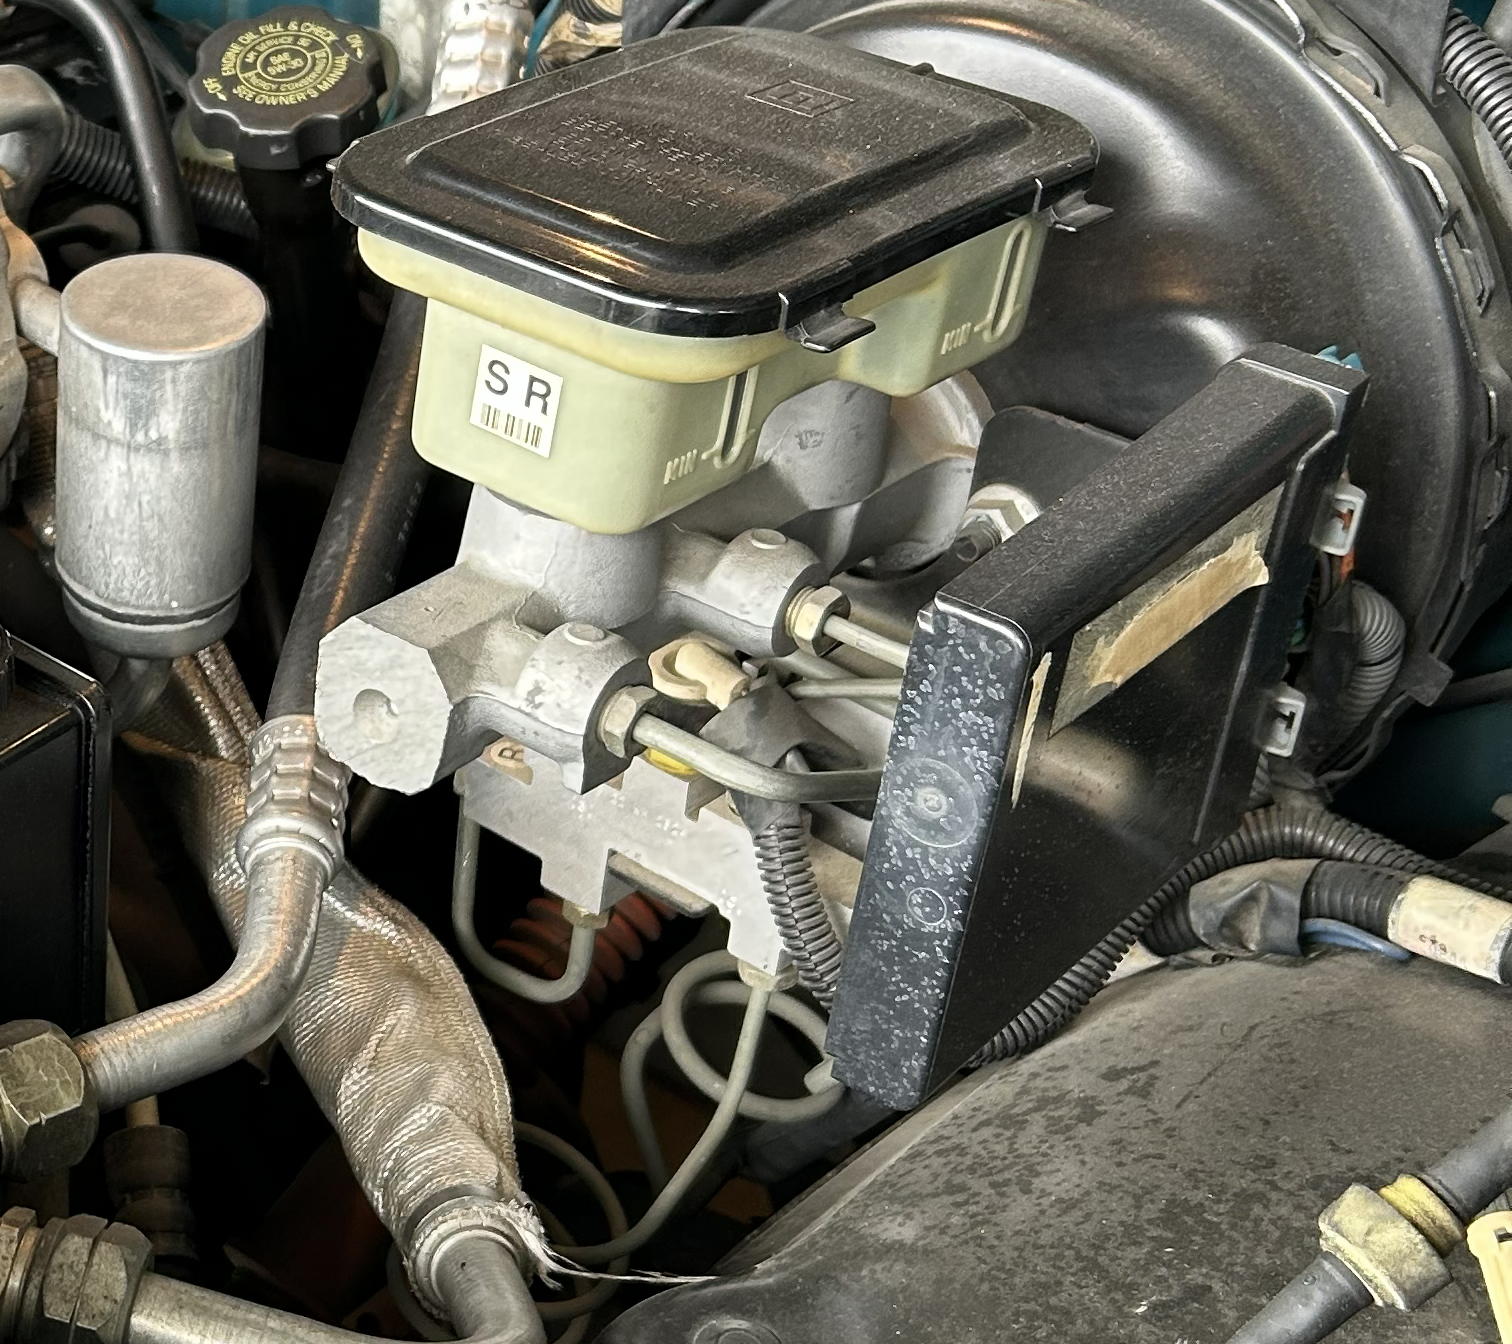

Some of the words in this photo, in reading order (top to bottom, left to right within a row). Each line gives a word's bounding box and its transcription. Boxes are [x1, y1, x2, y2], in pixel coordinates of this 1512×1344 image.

[221, 42, 244, 76] ENGINE
[238, 30, 261, 45] OIL
[258, 22, 284, 35] FILL
[300, 22, 339, 44] CHECK
[232, 84, 256, 102] SEE
[320, 52, 350, 92] MANUAL
